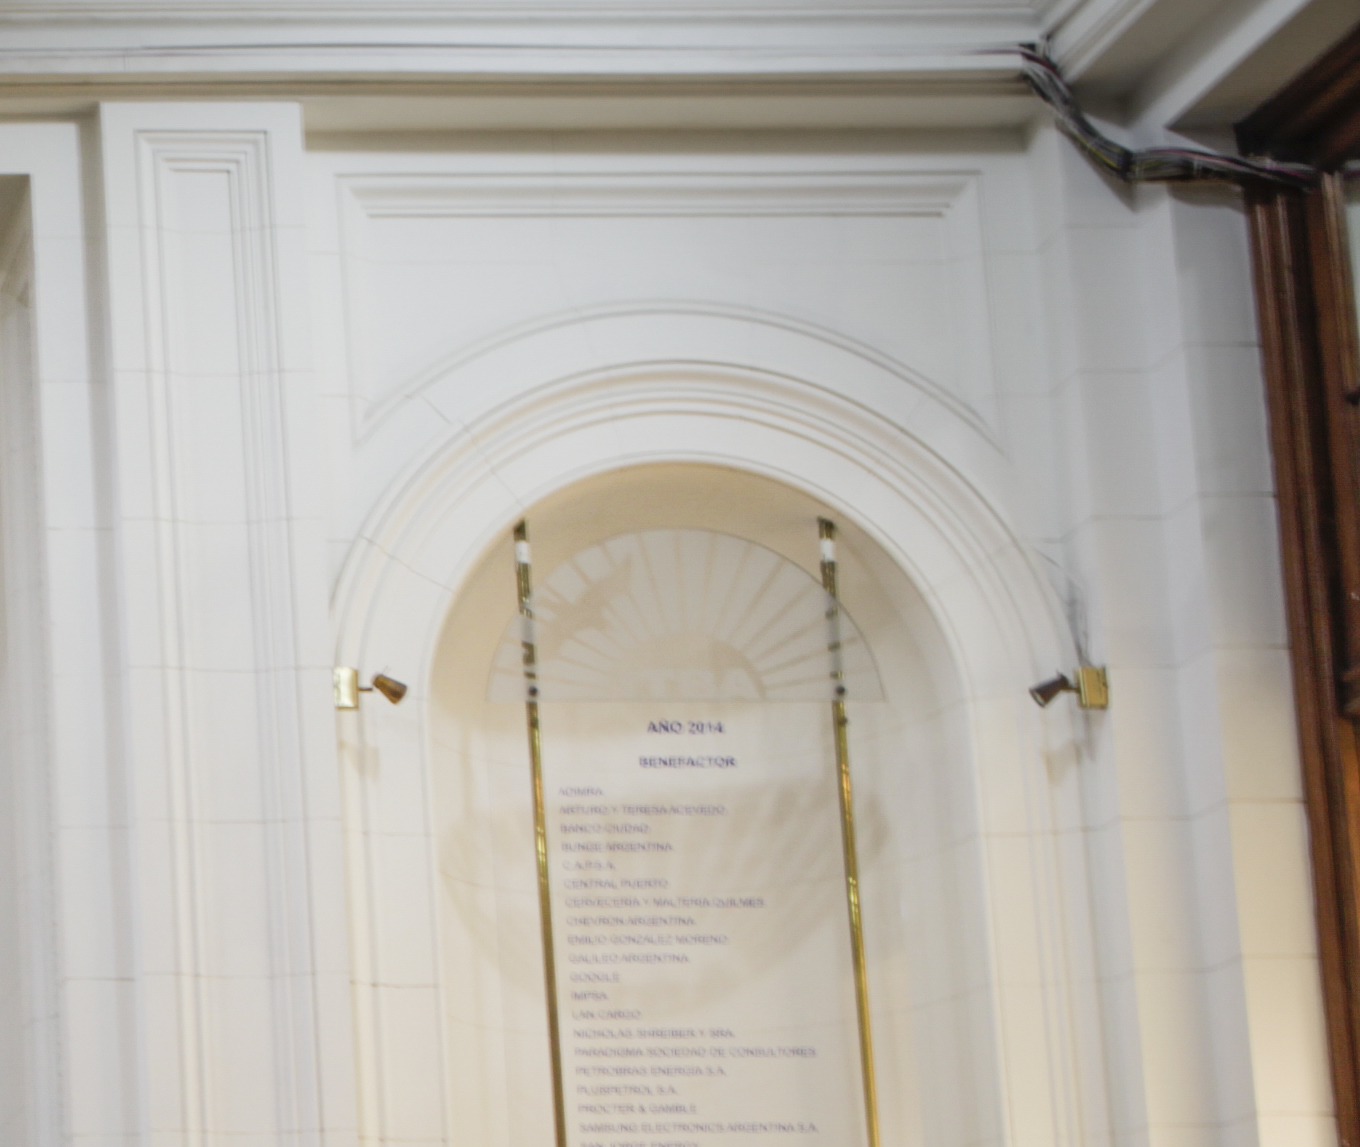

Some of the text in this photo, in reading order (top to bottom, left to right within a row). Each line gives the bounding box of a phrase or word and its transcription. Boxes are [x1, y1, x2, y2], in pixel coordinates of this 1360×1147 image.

[647, 718, 725, 734] AÑO 2014
[639, 756, 737, 768] BENEFACTOR
[559, 805, 609, 816] ARTURO
[622, 805, 668, 816] TERESA
[668, 805, 727, 816] ACEVEDO
[560, 823, 651, 834] BANCO CIUDAD
[561, 842, 673, 853] BUNGE ARGENTINA
[564, 878, 669, 890] CENTRAL PUERTO
[566, 915, 697, 927] CHEVRON ARGENTINA
[567, 934, 608, 945] EMILIO
[675, 934, 729, 945] MORENO
[569, 953, 690, 964] GALILEO ARGENTINA
[570, 972, 621, 983] GOOGLE
[572, 1010, 641, 1020] LAN CARGO
[573, 1028, 633, 1039] NICHOLAS
[646, 1047, 706, 1058] SOCIEDAD
[709, 1047, 725, 1058] DE
[729, 1047, 817, 1058] CONSULTORES
[576, 1066, 648, 1077] PETROBRAS
[577, 1085, 653, 1096] PLUSPETROL
[578, 1104, 698, 1114] PROCTER & GAMBLE
[579, 1122, 638, 1133] SAMSUNG
[641, 1122, 725, 1133] ELECTRONICS
[727, 1122, 796, 1132] ARGENTINA
